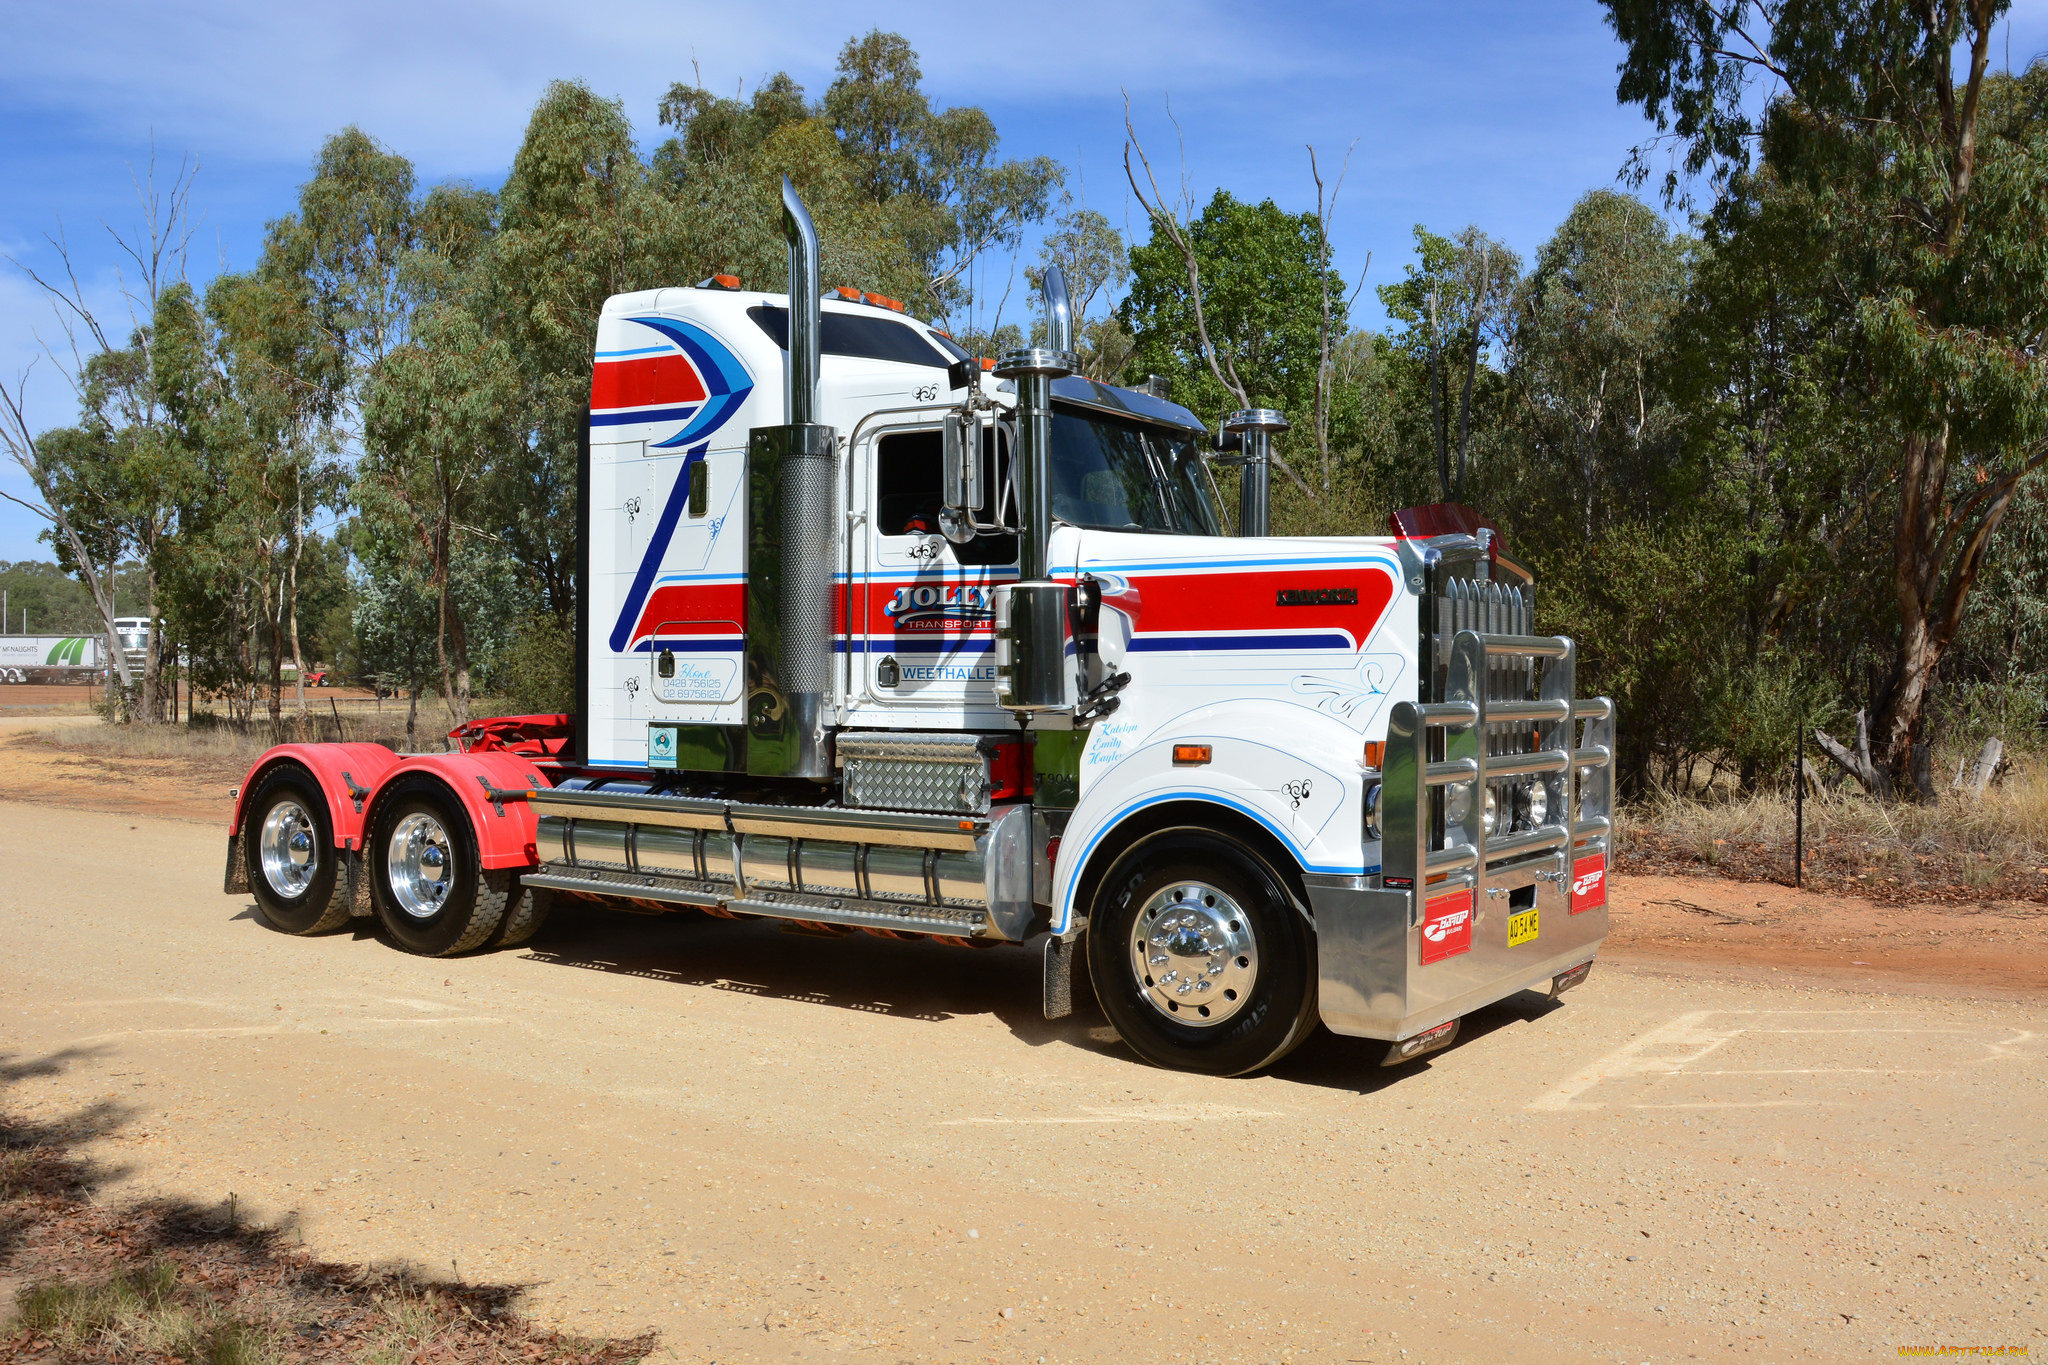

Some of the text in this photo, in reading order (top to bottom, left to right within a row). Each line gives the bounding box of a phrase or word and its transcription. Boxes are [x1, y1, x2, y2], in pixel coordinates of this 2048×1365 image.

[884, 586, 996, 617] JOLLY
[1277, 588, 1358, 606] KENWORTH
[908, 620, 991, 628] TRANSPORT
[902, 667, 995, 680] WEETHALLE
[663, 679, 721, 688] 0428 756125
[663, 689, 721, 699] 02 69756125
[1093, 737, 1122, 751] Emily
